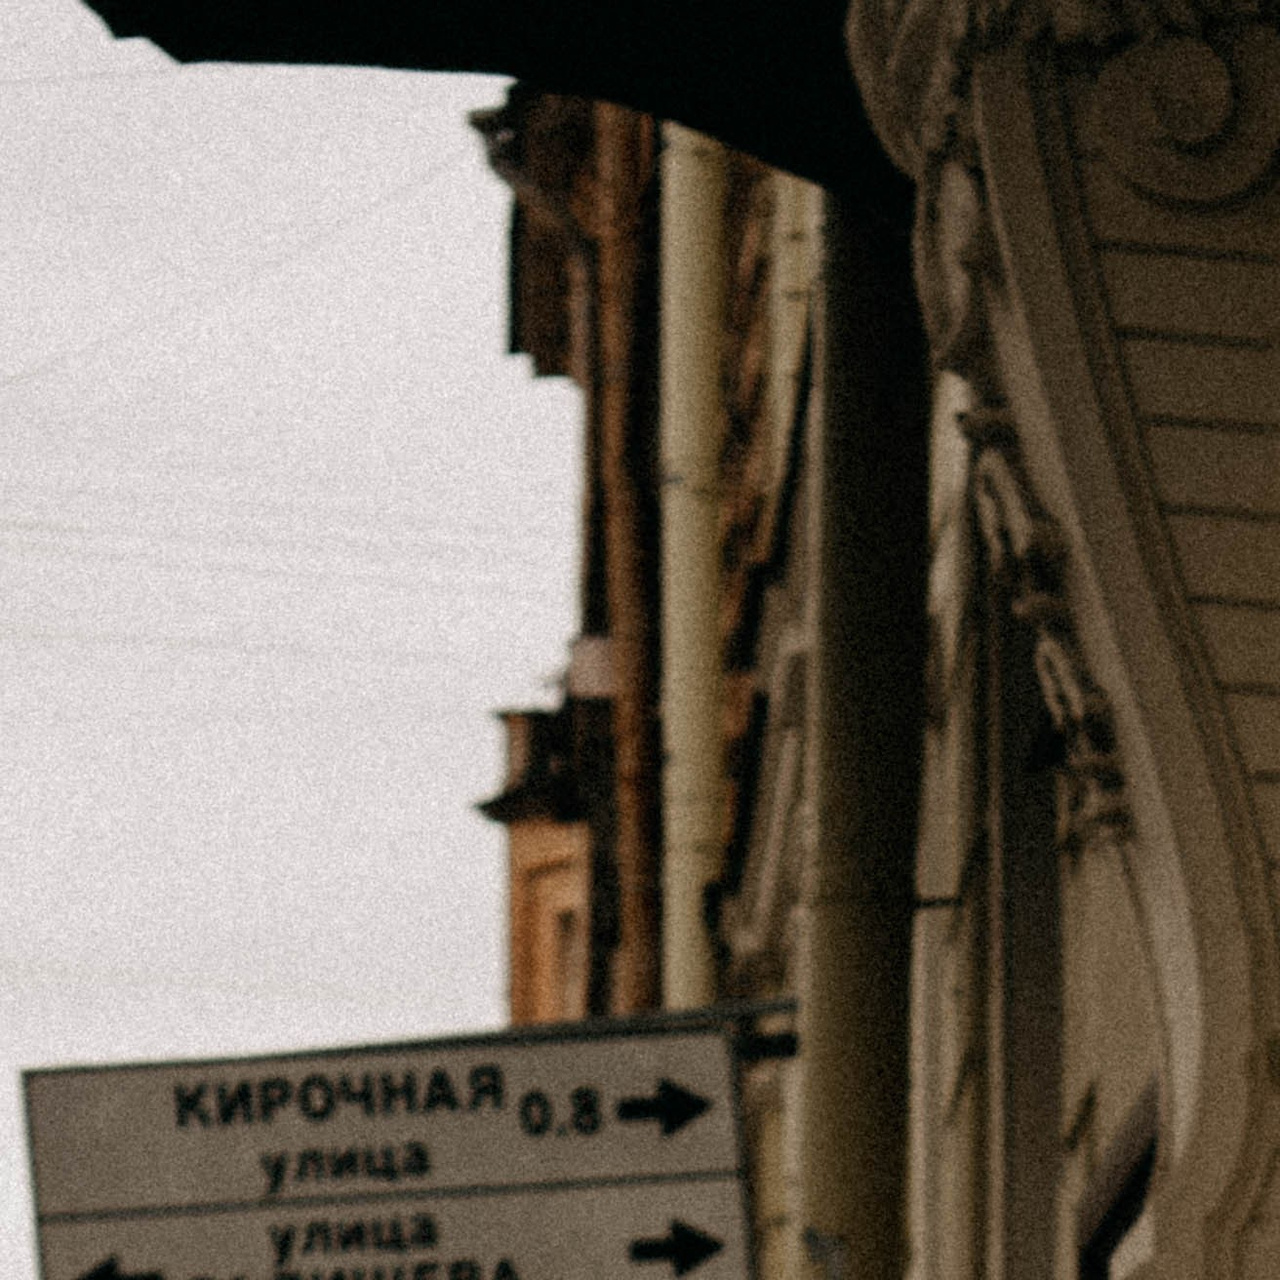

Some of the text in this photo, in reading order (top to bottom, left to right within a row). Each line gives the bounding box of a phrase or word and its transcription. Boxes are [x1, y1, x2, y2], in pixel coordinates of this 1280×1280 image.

[173, 1064, 506, 1127] КИРОЧНАЯ
[261, 1139, 432, 1193] улица
[269, 1212, 439, 1264] улица
